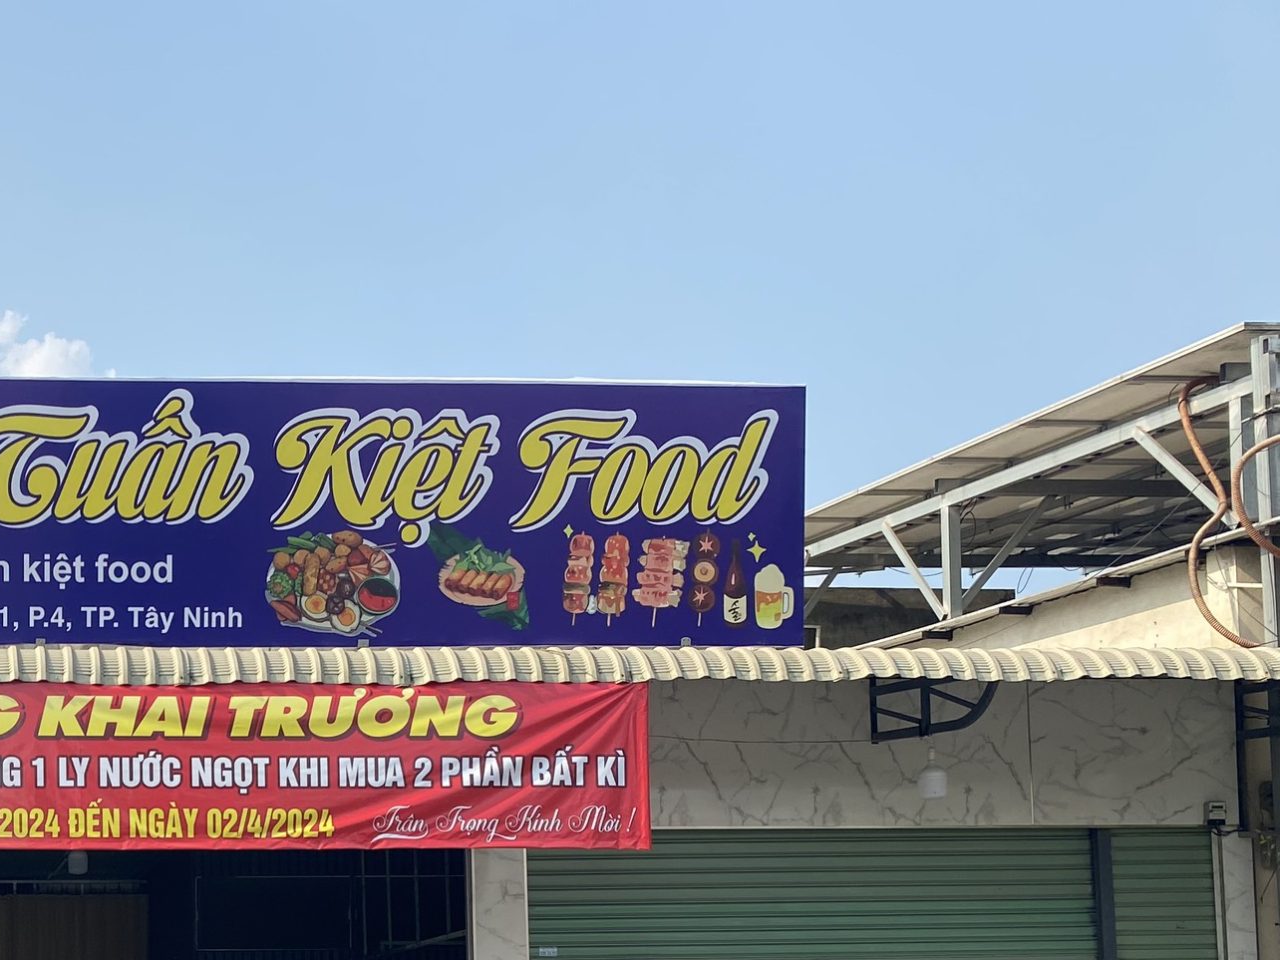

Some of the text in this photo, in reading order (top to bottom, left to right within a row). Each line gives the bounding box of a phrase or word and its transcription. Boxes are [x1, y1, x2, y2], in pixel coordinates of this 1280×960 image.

[270, 407, 500, 548] Kiệt
[509, 409, 779, 533] Food
[23, 553, 85, 590] kiệt
[95, 554, 174, 583] food
[29, 607, 72, 631] P.4,
[81, 607, 119, 628] TP.
[128, 607, 175, 634] Tây
[183, 607, 243, 629] Ninh
[36, 694, 209, 739] KHAI
[31, 757, 45, 788] 1
[58, 757, 90, 788] LY
[99, 750, 182, 788] NƯỚC
[191, 756, 270, 794] NGỌT
[279, 757, 328, 788] KHI
[339, 757, 406, 788] MUA
[414, 757, 432, 788] 2
[441, 746, 524, 788] PHẦN
[532, 745, 588, 787] BẤT
[597, 749, 626, 787] KÌ
[68, 798, 120, 838] ĐẾN
[129, 802, 199, 838] NGÀY
[206, 807, 334, 838] 02/4/2024
[371, 805, 428, 843] Trân
[436, 805, 516, 843] Trọng
[505, 804, 563, 833] Kính
[568, 805, 622, 833] Mời
